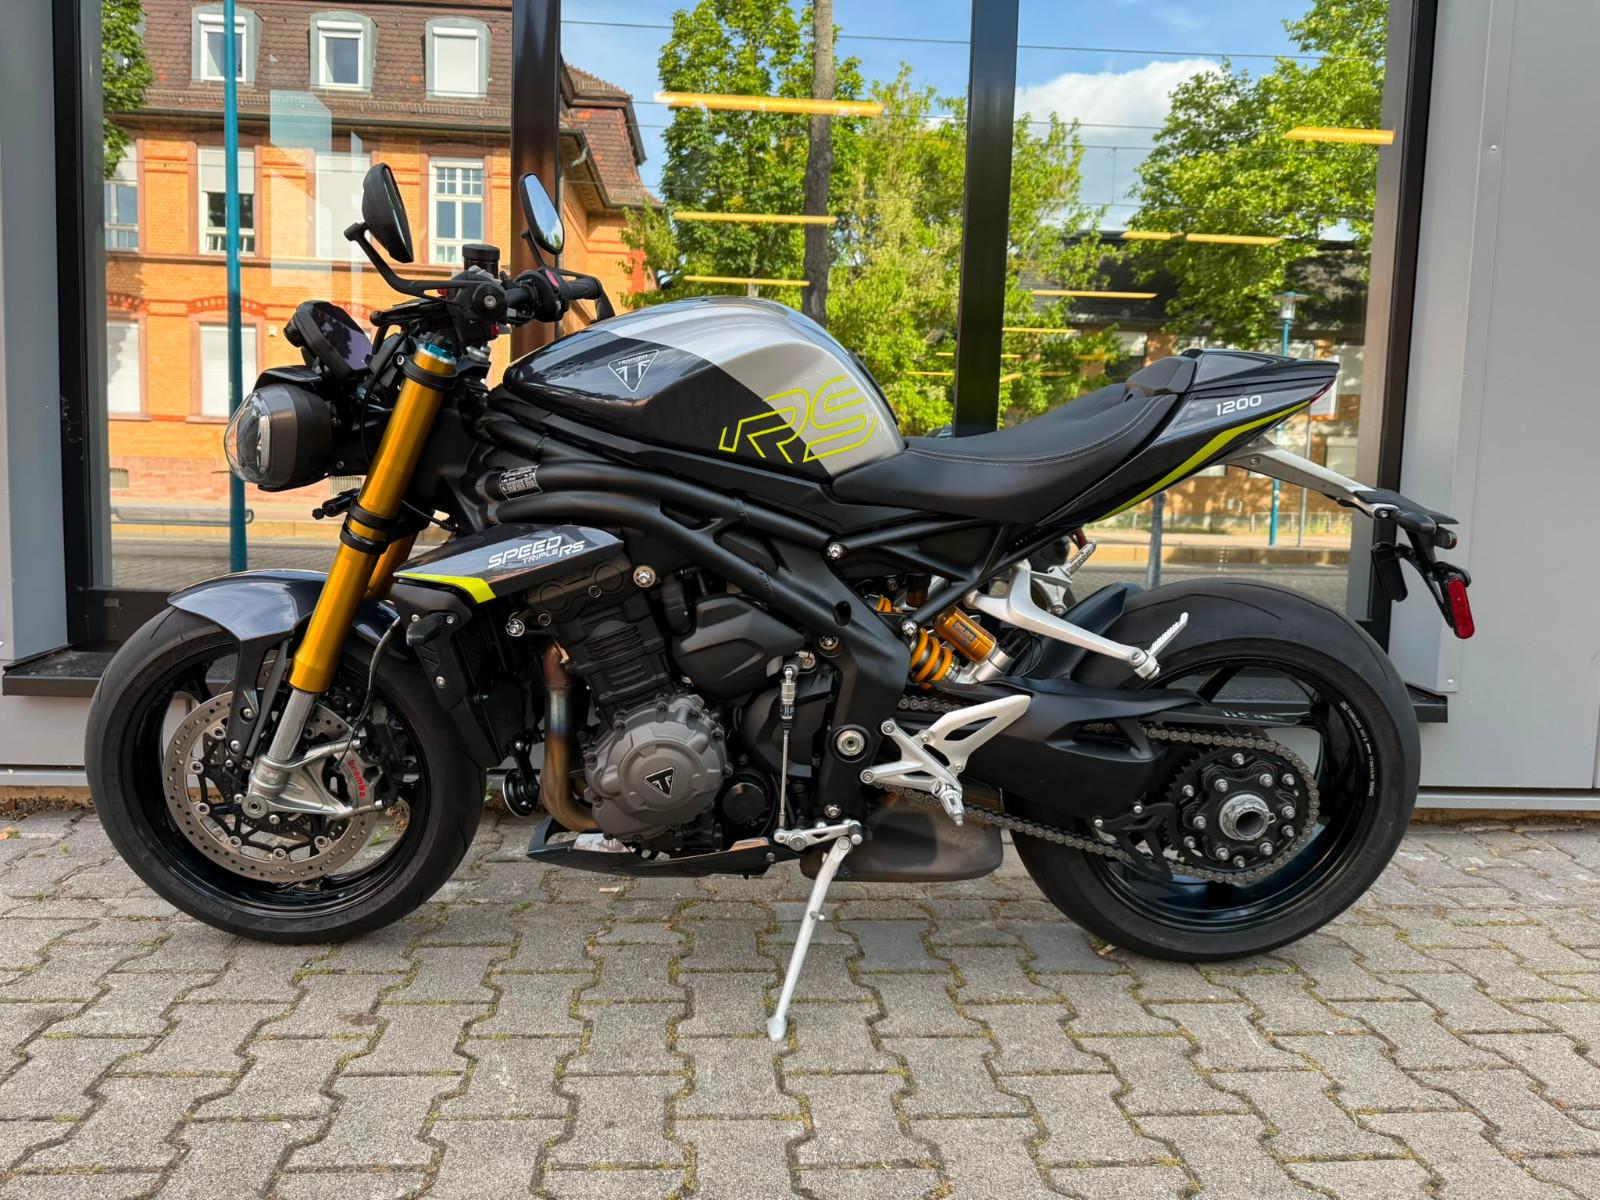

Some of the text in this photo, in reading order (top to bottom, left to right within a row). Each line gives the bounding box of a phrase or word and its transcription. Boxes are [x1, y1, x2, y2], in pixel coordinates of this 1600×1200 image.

[719, 375, 878, 464] RS
[1216, 394, 1262, 416] 1200
[487, 535, 562, 569] SPEED
[522, 540, 586, 565] TRIPLE RS
[347, 759, 368, 799] brembo
